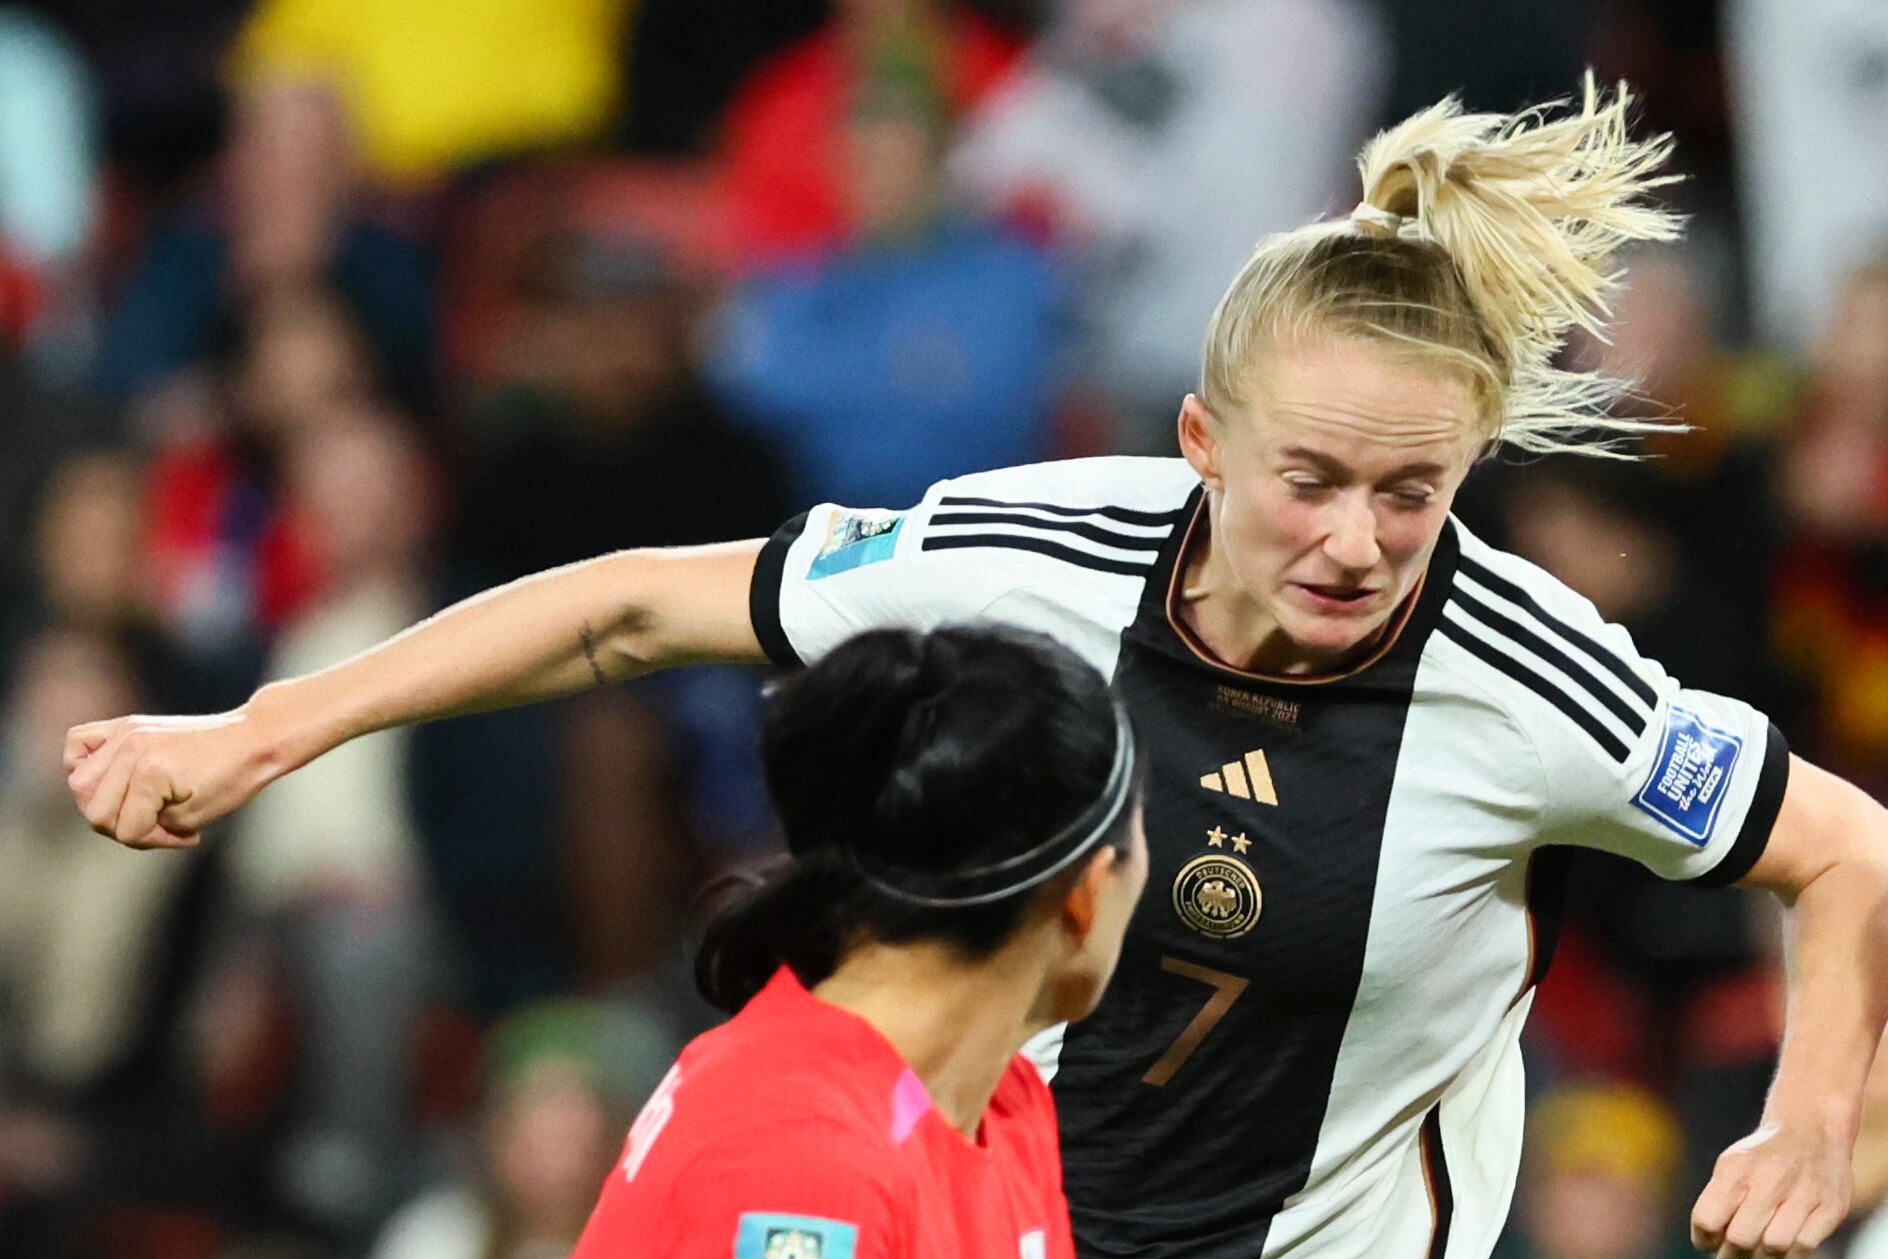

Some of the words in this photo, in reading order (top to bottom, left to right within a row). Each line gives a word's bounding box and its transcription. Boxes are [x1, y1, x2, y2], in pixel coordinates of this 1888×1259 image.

[1657, 732, 1691, 793] FOOTBALL
[1667, 738, 1701, 801] UNITES
[1142, 956, 1250, 1087] 7
